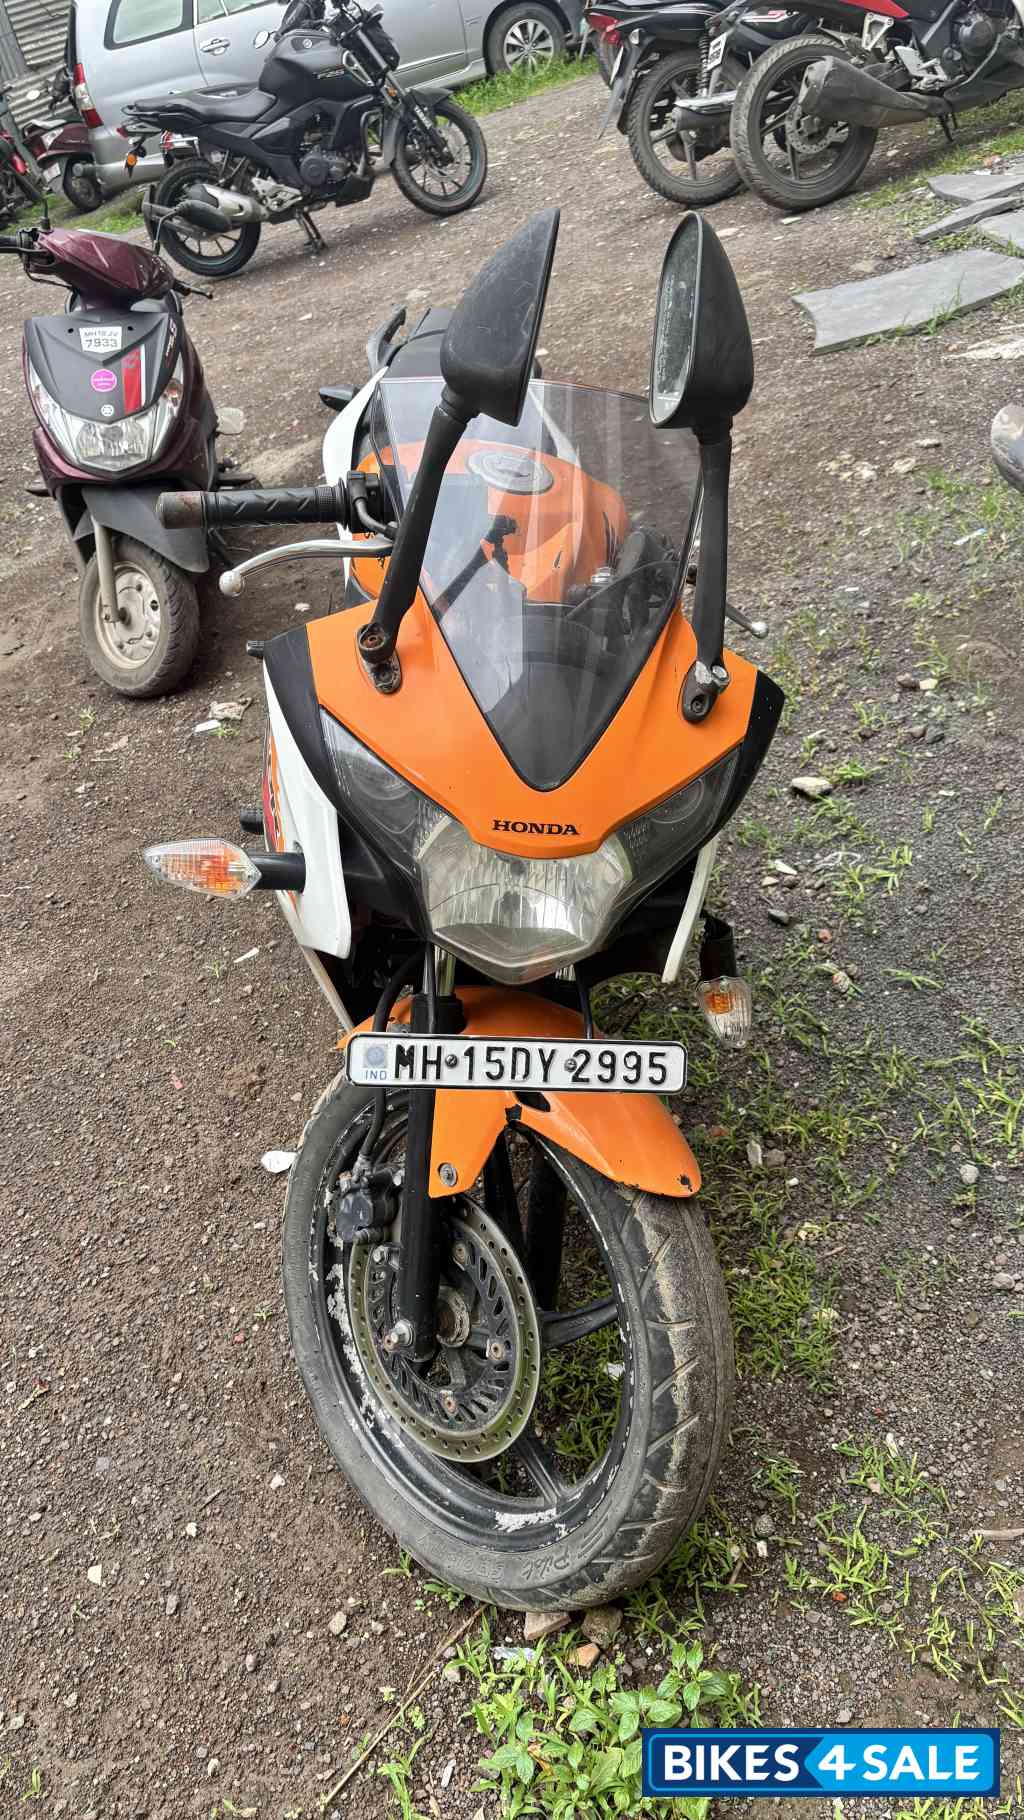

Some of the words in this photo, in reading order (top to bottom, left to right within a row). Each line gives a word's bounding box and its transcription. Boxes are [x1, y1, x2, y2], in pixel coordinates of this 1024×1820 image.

[85, 338, 118, 348] 7933
[492, 819, 579, 836] HONDA
[394, 1043, 442, 1080] MH
[571, 1048, 667, 1085] 2995
[365, 1069, 388, 1081] IND
